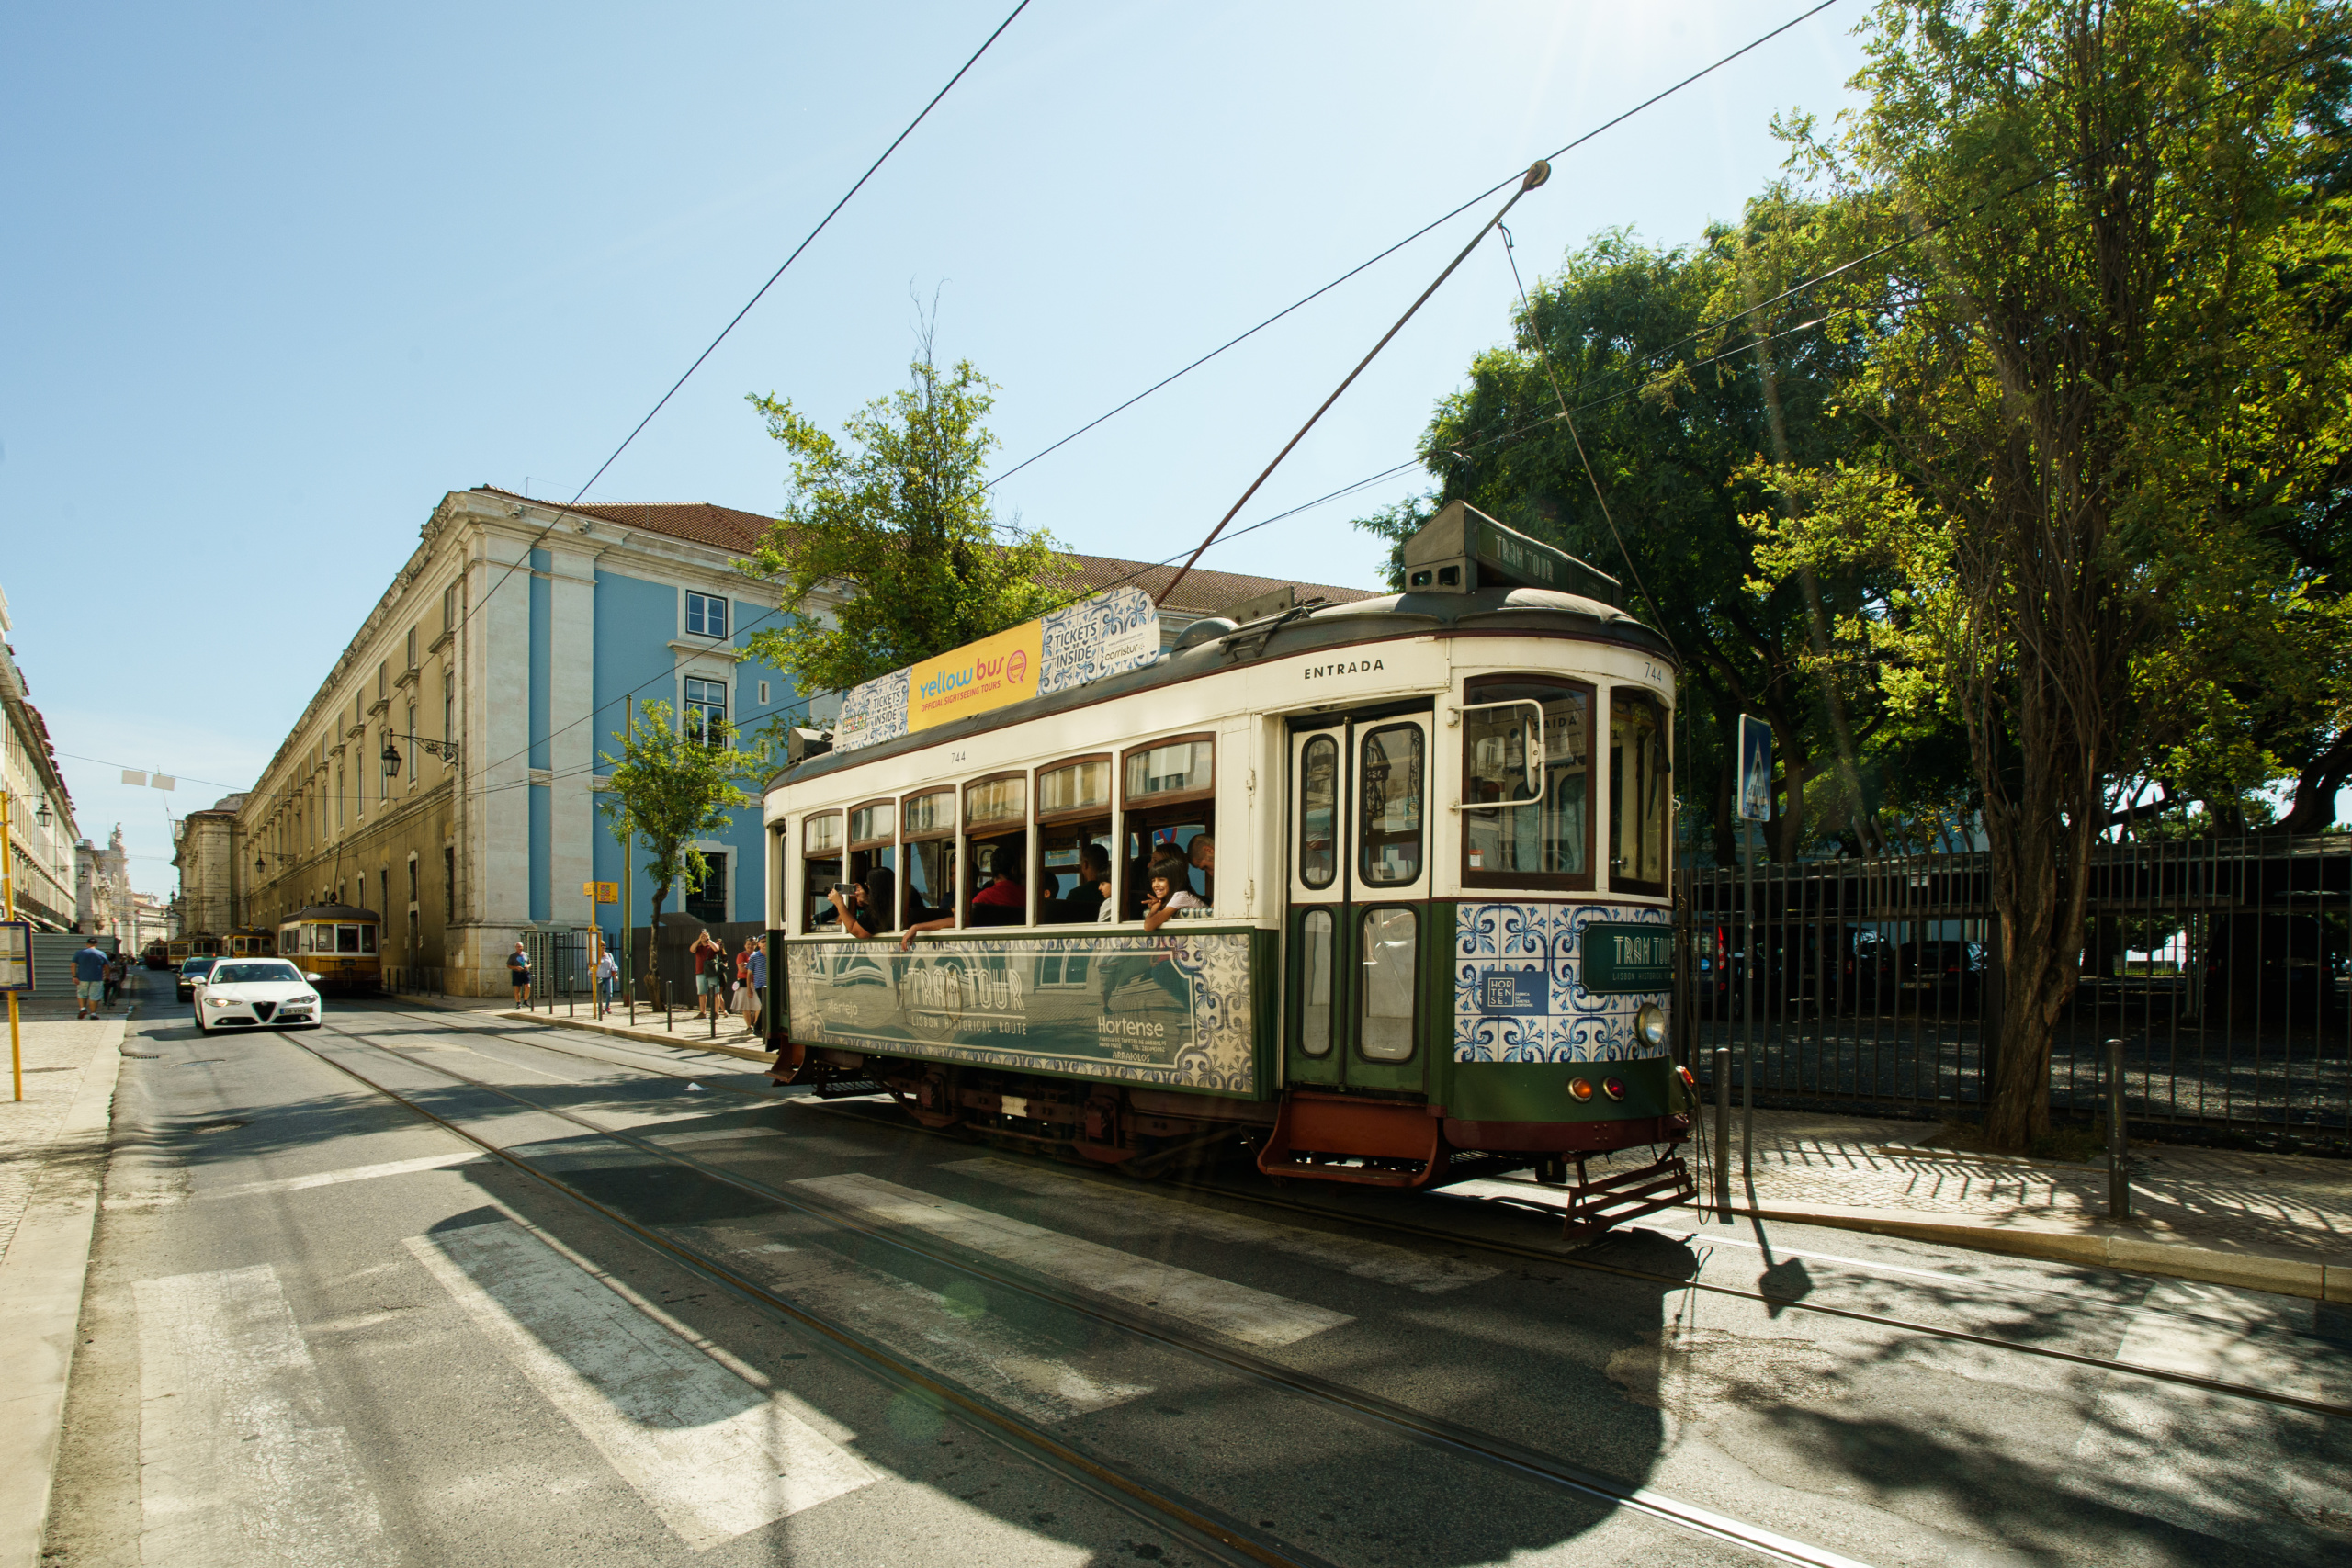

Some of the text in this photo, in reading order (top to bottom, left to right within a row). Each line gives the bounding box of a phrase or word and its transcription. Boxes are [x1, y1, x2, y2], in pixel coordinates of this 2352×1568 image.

[1495, 535, 1554, 583] TRAM TOUR
[1055, 622, 1097, 648] TICKETS
[1057, 645, 1091, 669] INSIDE
[1105, 643, 1138, 660] carristur
[920, 667, 973, 699] yellow
[977, 656, 1004, 681] bus
[1305, 659, 1384, 680] ENTRADA
[1645, 661, 1662, 683] 744
[873, 690, 901, 709] TICKETS
[921, 680, 1001, 713] OFFICIAL SIGHTSEEING TOURS
[874, 708, 897, 727] INSIDE
[951, 750, 966, 764] 744
[1613, 935, 1650, 964] TRAM
[1490, 980, 1512, 988] HOR
[1612, 972, 1635, 981] LISBON
[908, 967, 1025, 1010] TRAM TOUR
[1490, 988, 1511, 997] TEN
[1490, 997, 1508, 1005] SE.
[911, 1015, 1027, 1035] LISBON HISTORICAL ROUTE
[1097, 1015, 1164, 1037] Hortense
[1113, 1051, 1150, 1063] ARRAIOLOS
